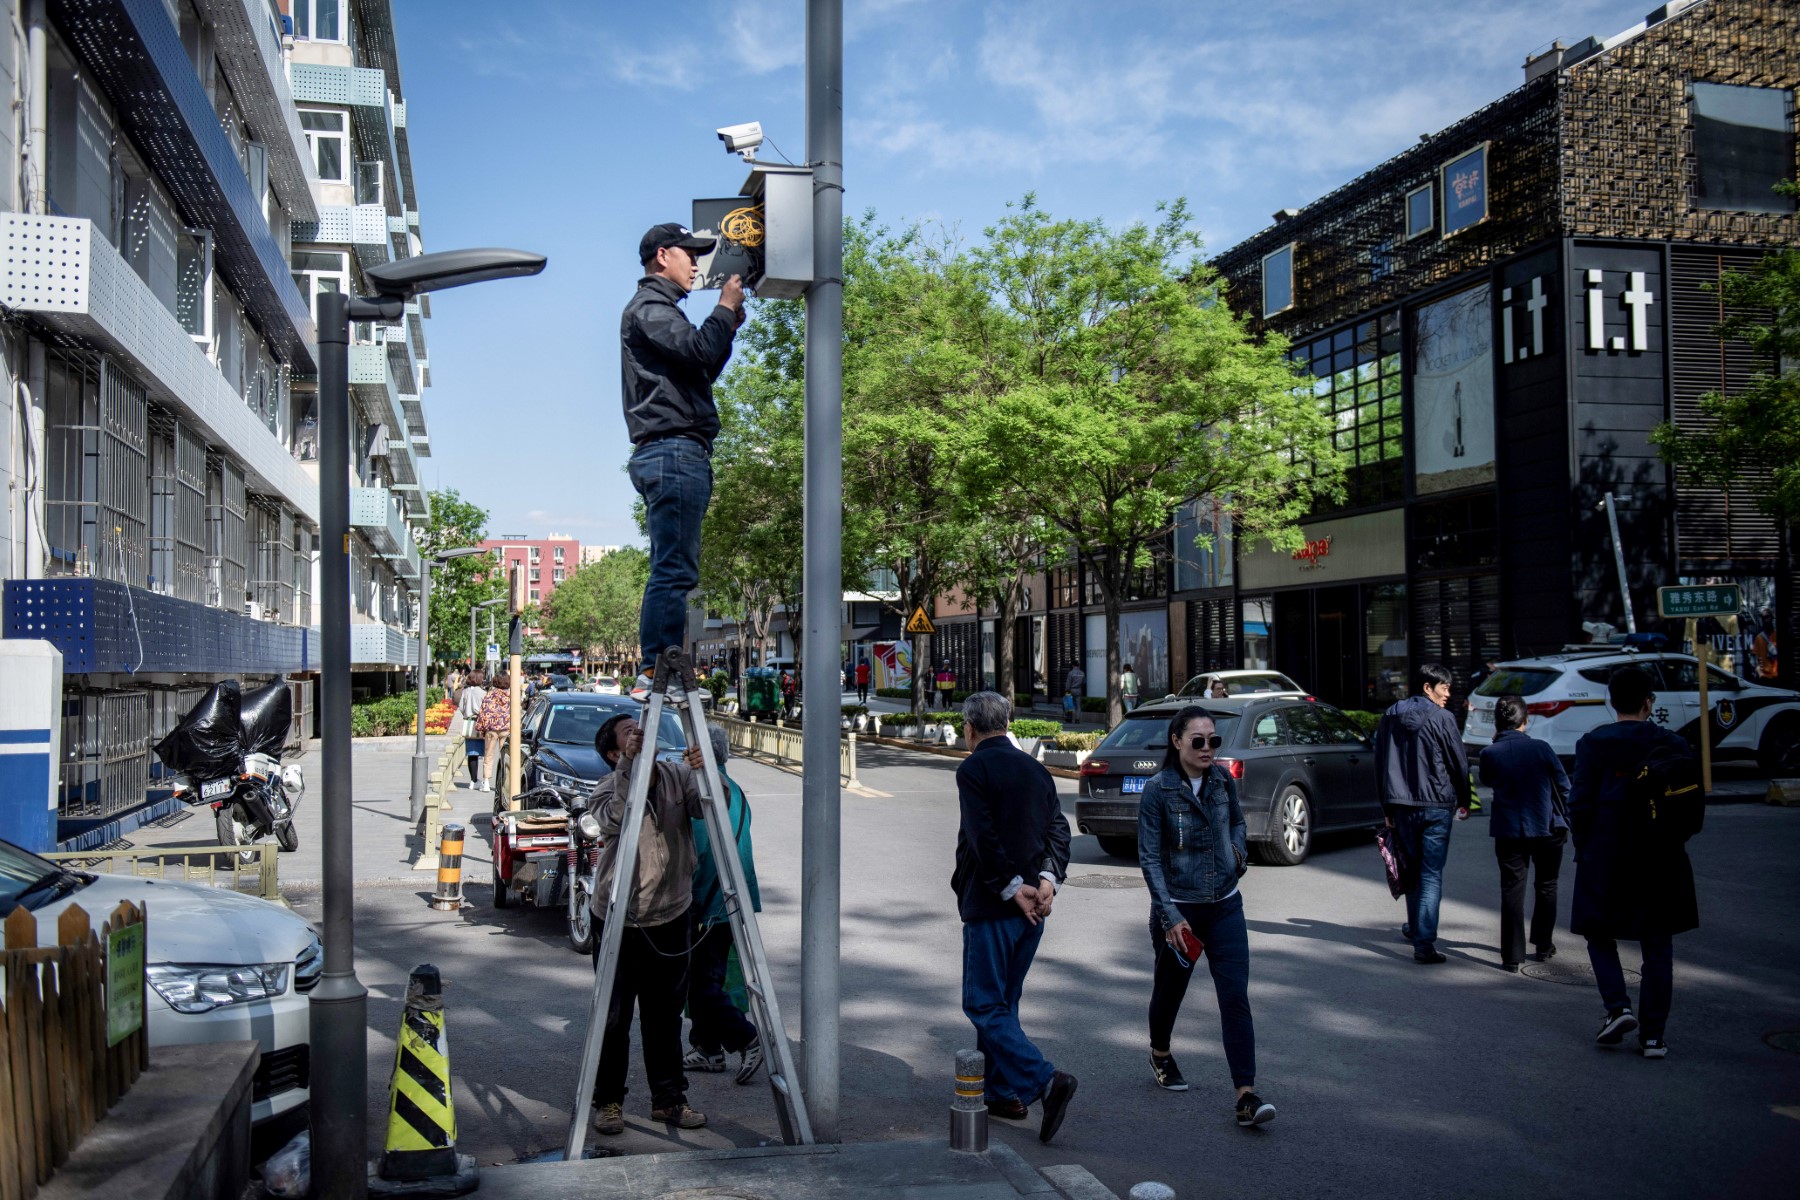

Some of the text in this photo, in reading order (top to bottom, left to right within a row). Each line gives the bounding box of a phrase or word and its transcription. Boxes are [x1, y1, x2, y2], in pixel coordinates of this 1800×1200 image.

[1502, 276, 1548, 365] i.t
[1588, 269, 1652, 350] i.t
[1669, 590, 1718, 604] 雅秀东路
